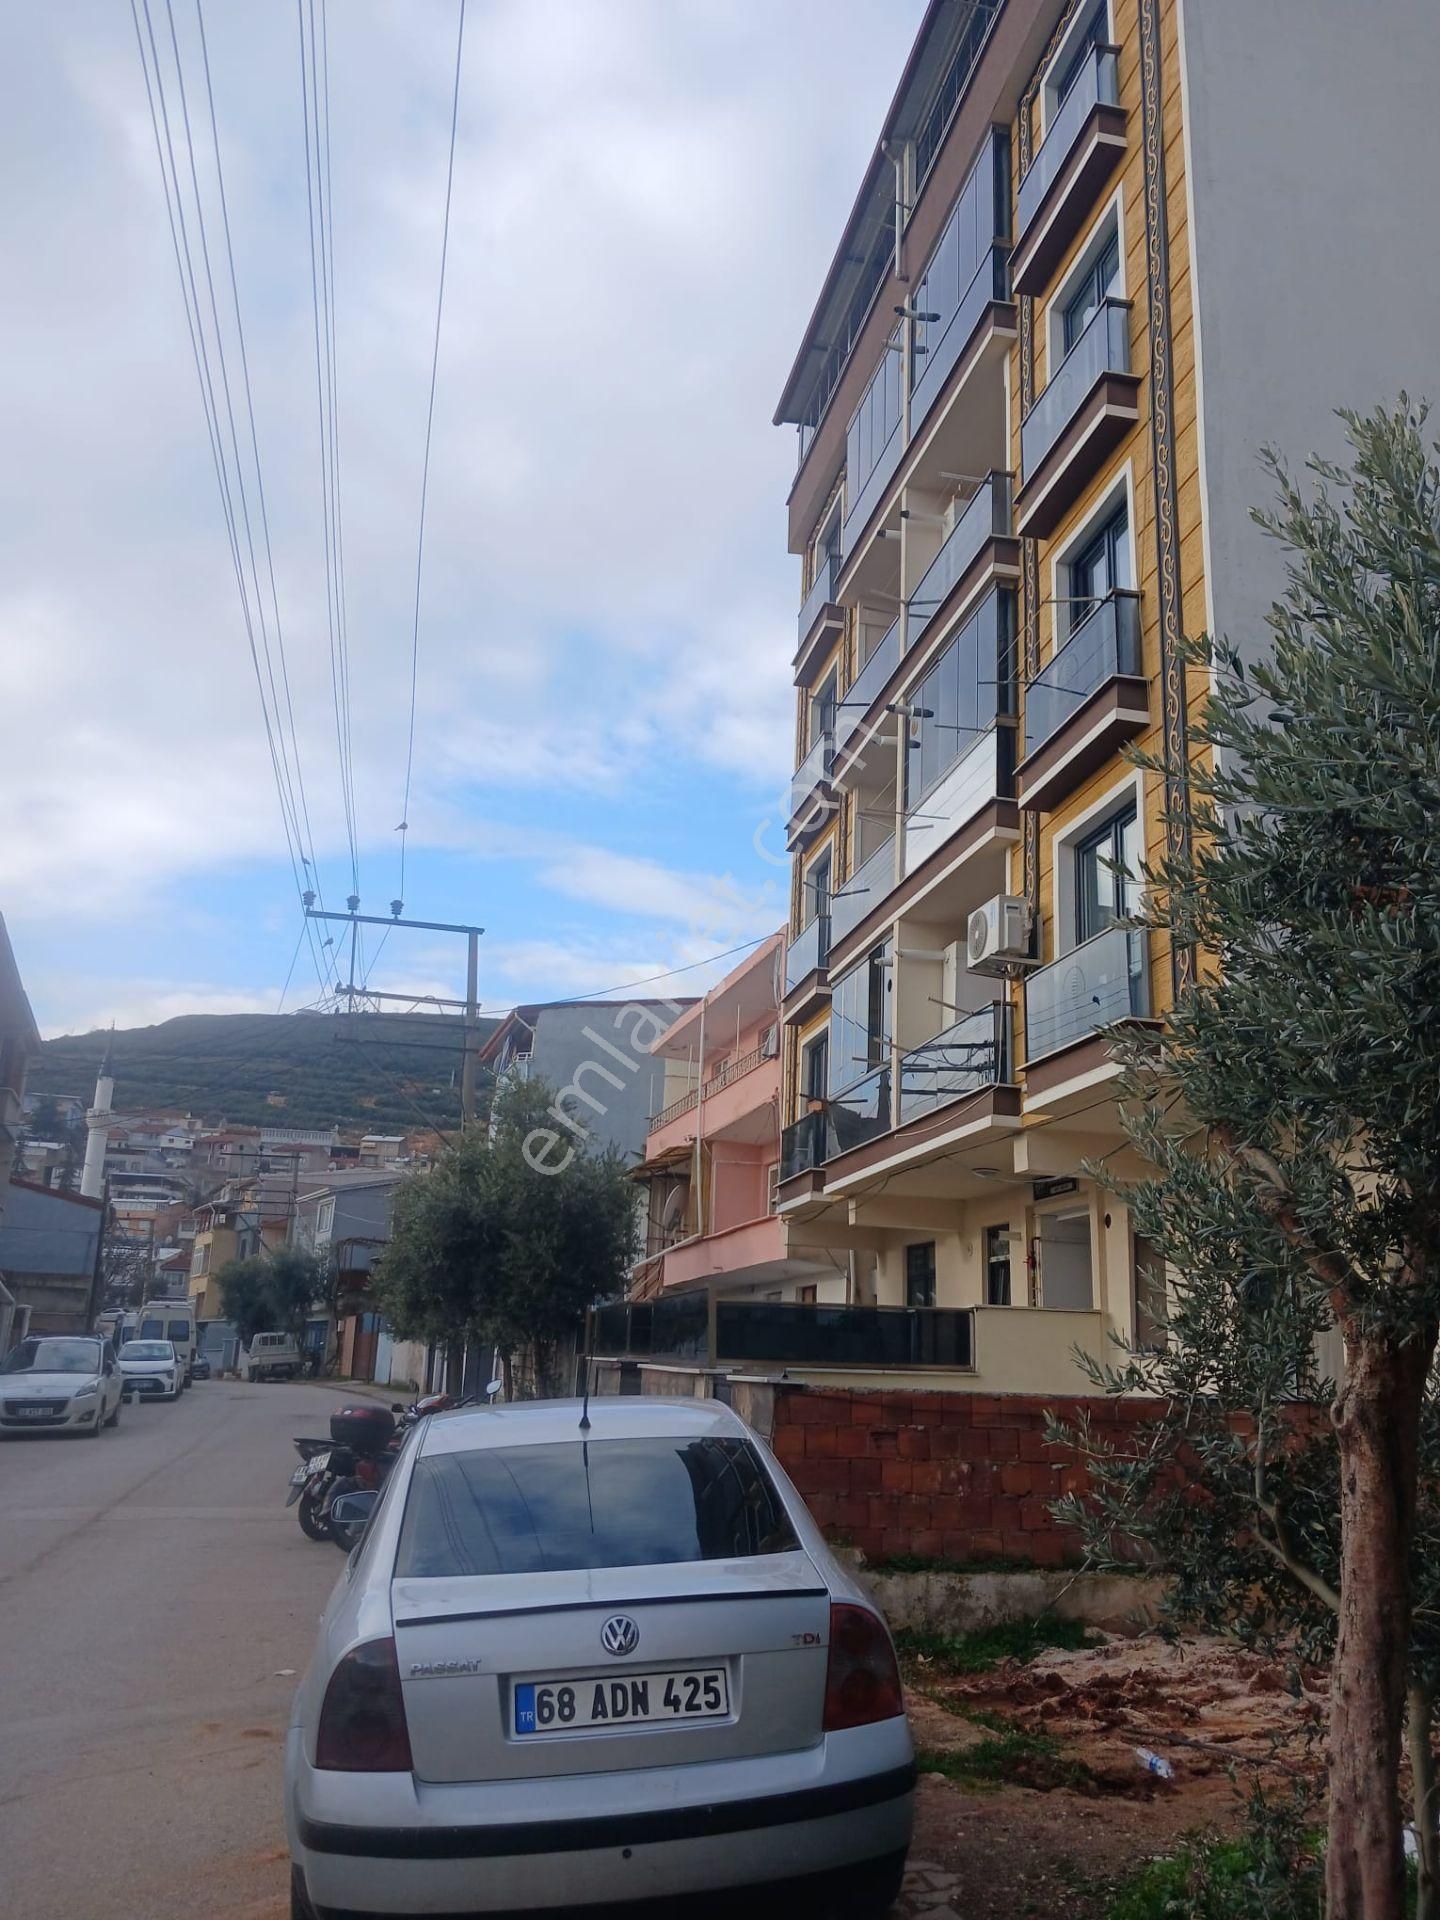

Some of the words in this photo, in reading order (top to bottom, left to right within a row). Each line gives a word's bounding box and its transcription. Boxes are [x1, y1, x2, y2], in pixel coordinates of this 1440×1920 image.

[409, 1659, 482, 1677] PASSAT
[536, 1687, 576, 1725] 68
[591, 1680, 650, 1720] ADN
[663, 1675, 721, 1713] 425
[520, 1711, 534, 1722] TR
